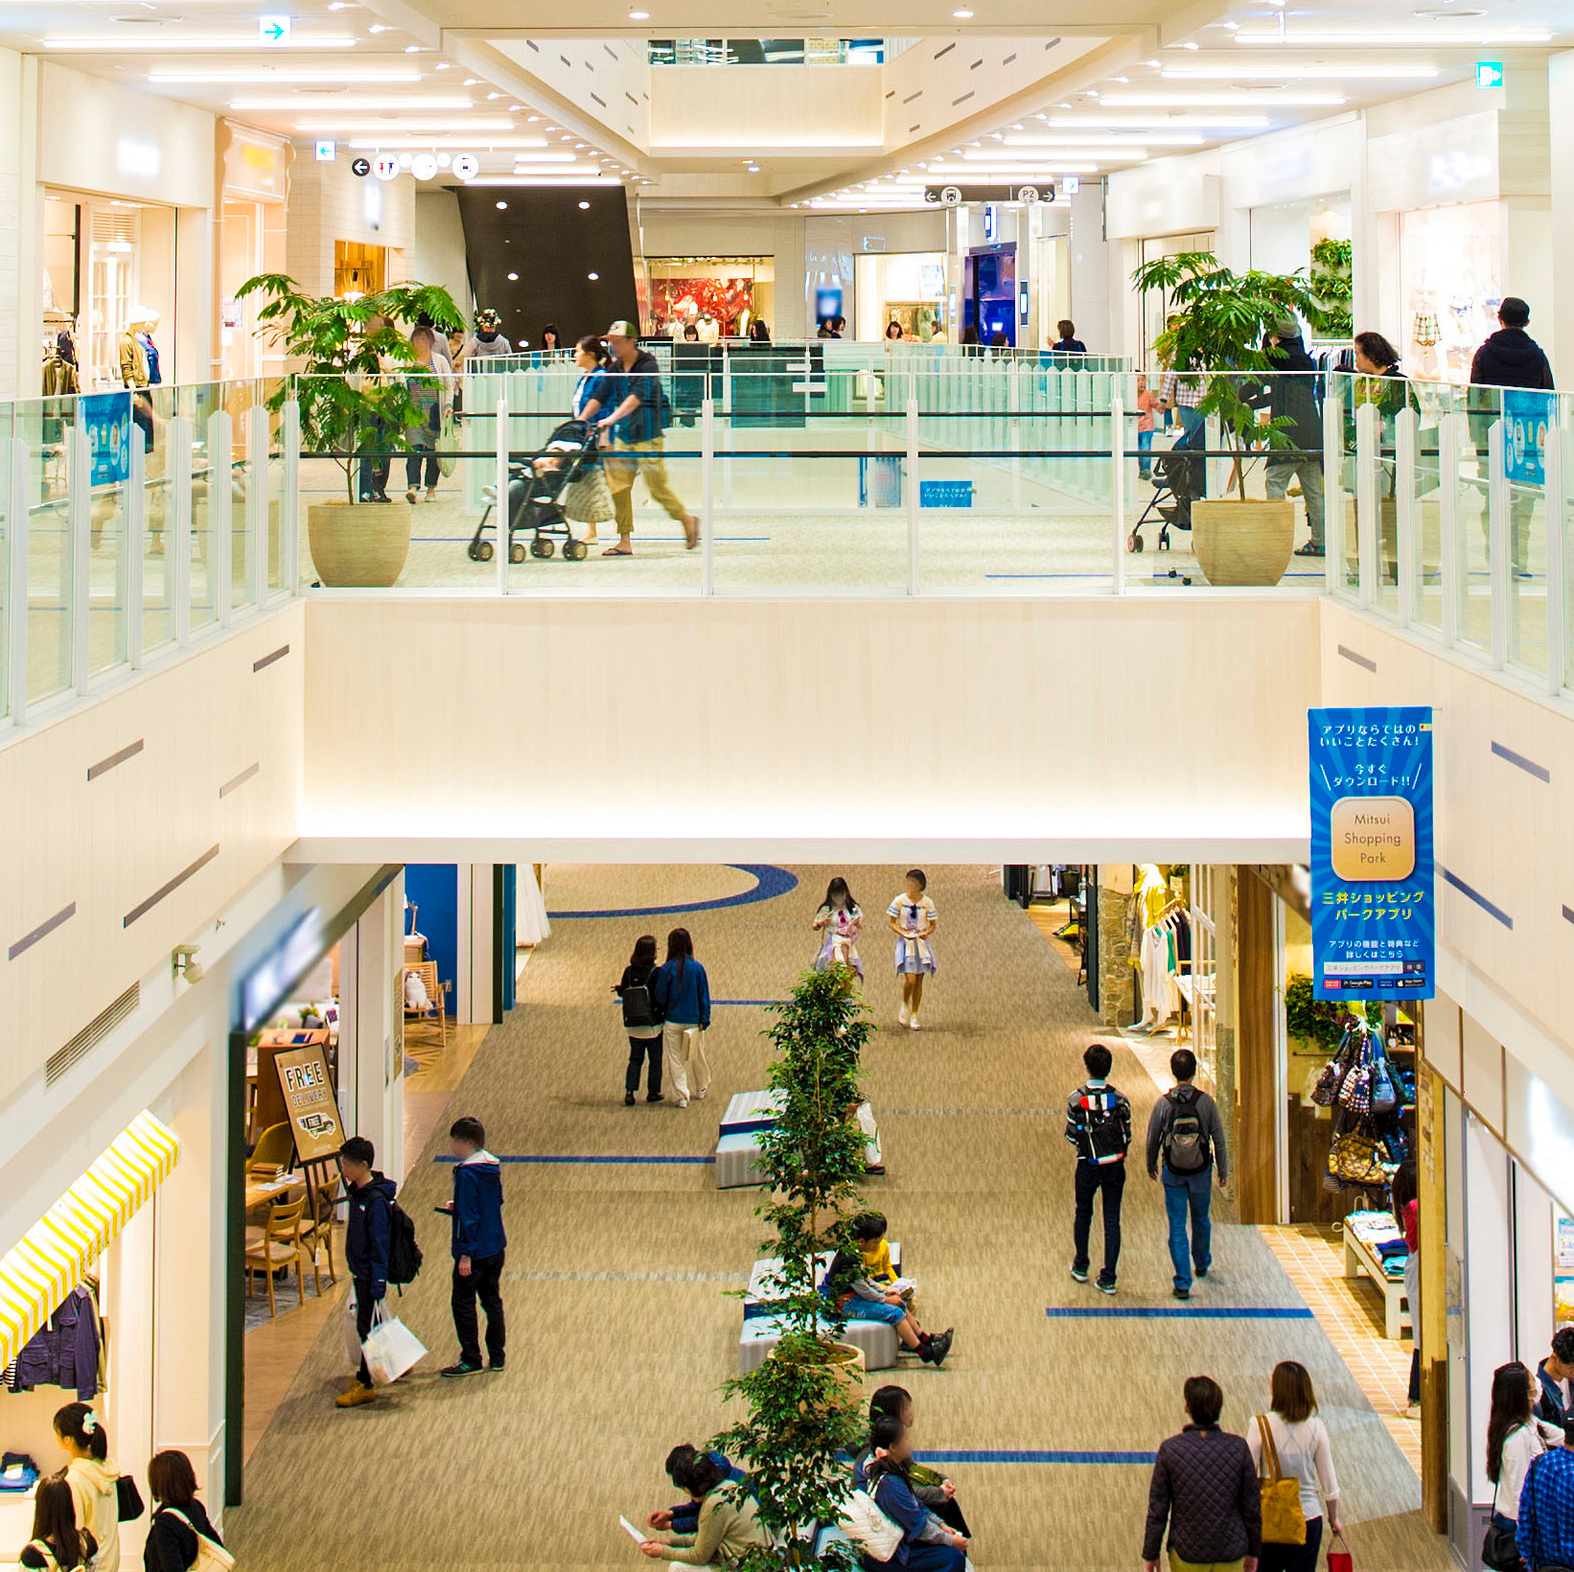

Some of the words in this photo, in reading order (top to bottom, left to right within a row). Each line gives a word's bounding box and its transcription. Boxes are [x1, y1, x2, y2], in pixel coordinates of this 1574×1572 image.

[1022, 190, 1034, 198] P2
[1323, 724, 1416, 736] アプリならではの
[1320, 736, 1418, 747] いいことたくさん!
[1355, 764, 1386, 774] 今すぐ
[1333, 776, 1410, 787] ダウンロード!!
[1354, 814, 1391, 825] Mitsui
[1344, 832, 1401, 847] Shopping
[1360, 852, 1386, 864] Park
[1322, 891, 1425, 905] 三井ショッピング
[1335, 908, 1412, 921] パークアプリ
[285, 1061, 324, 1092] FREE
[291, 1089, 327, 1107] DELIVERY
